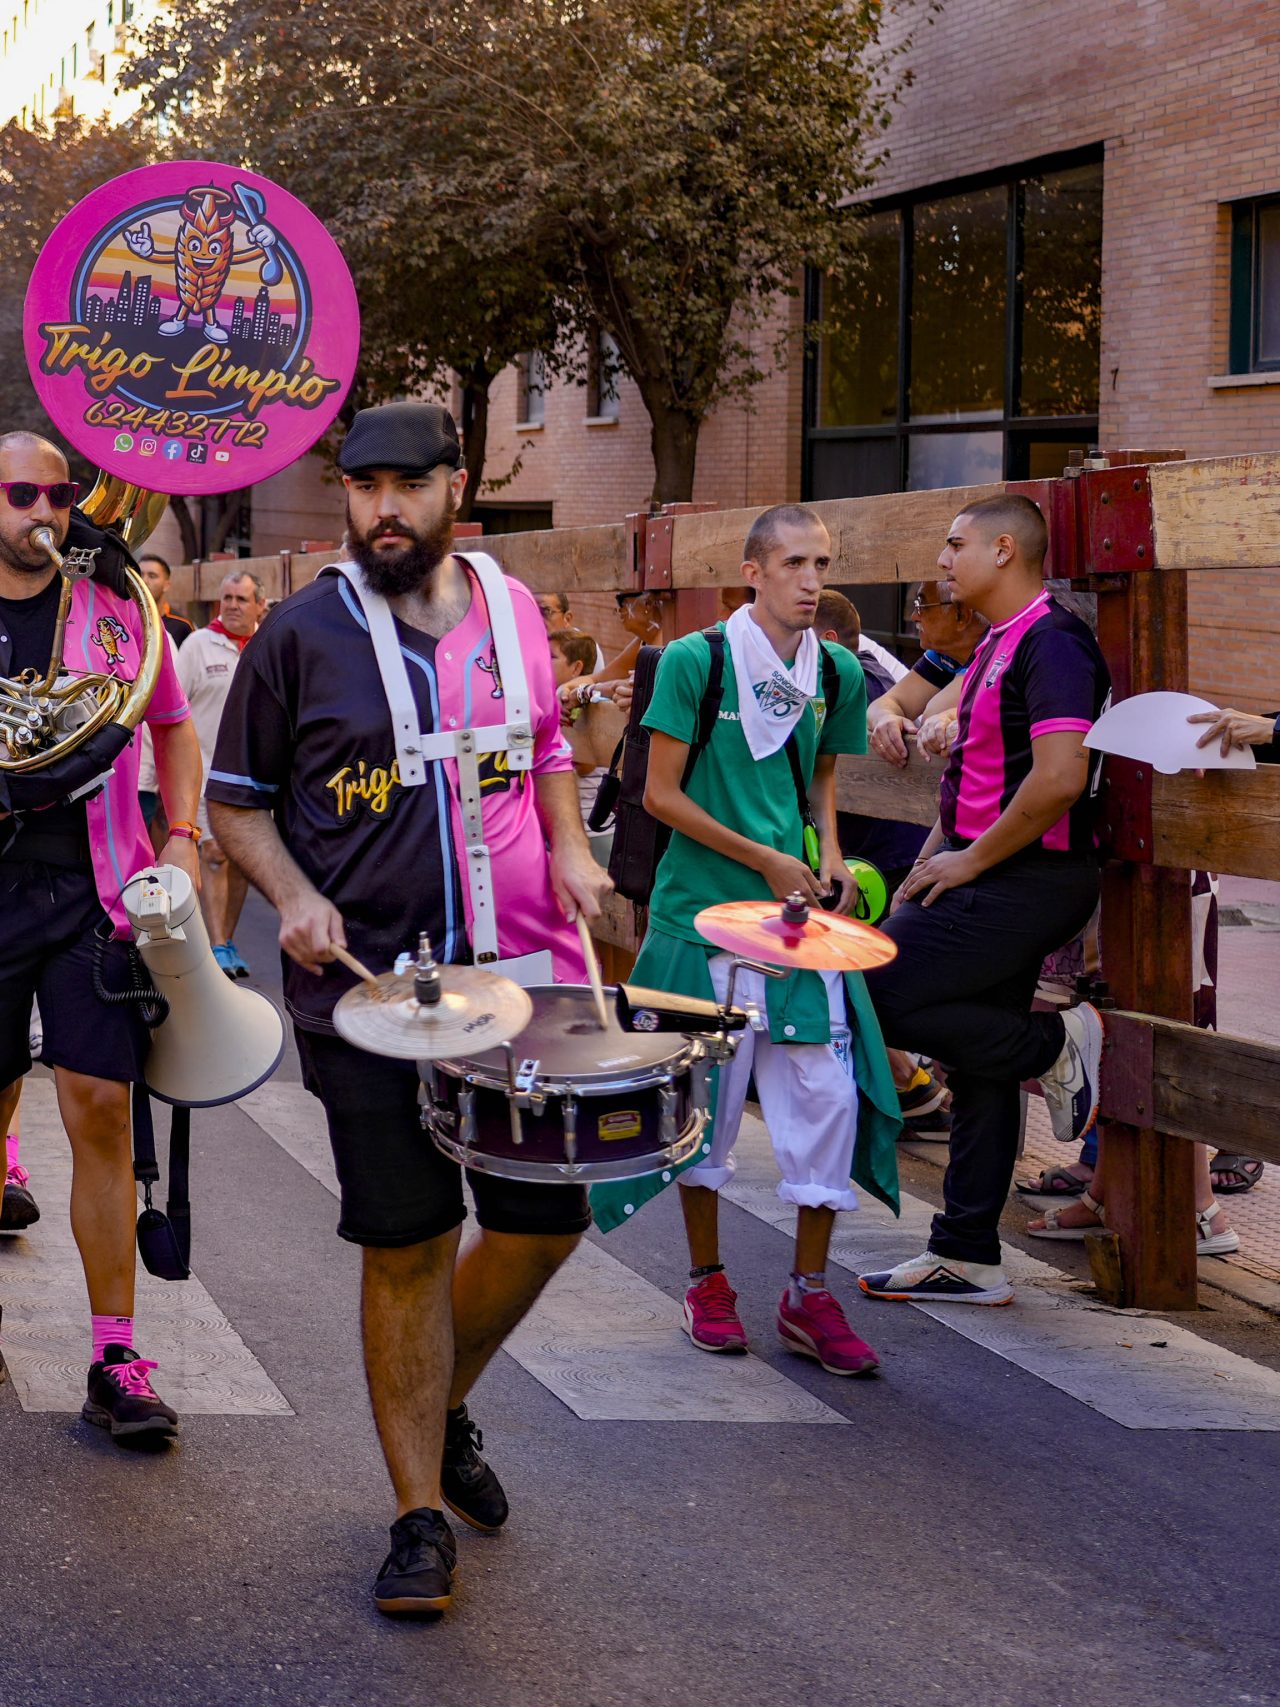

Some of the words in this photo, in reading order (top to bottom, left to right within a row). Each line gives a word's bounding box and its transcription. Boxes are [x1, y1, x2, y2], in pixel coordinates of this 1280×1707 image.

[44, 325, 166, 391] Trigo
[165, 344, 337, 412] Limpio
[84, 400, 268, 447] 624432772
[771, 670, 808, 699] SONIQUETE
